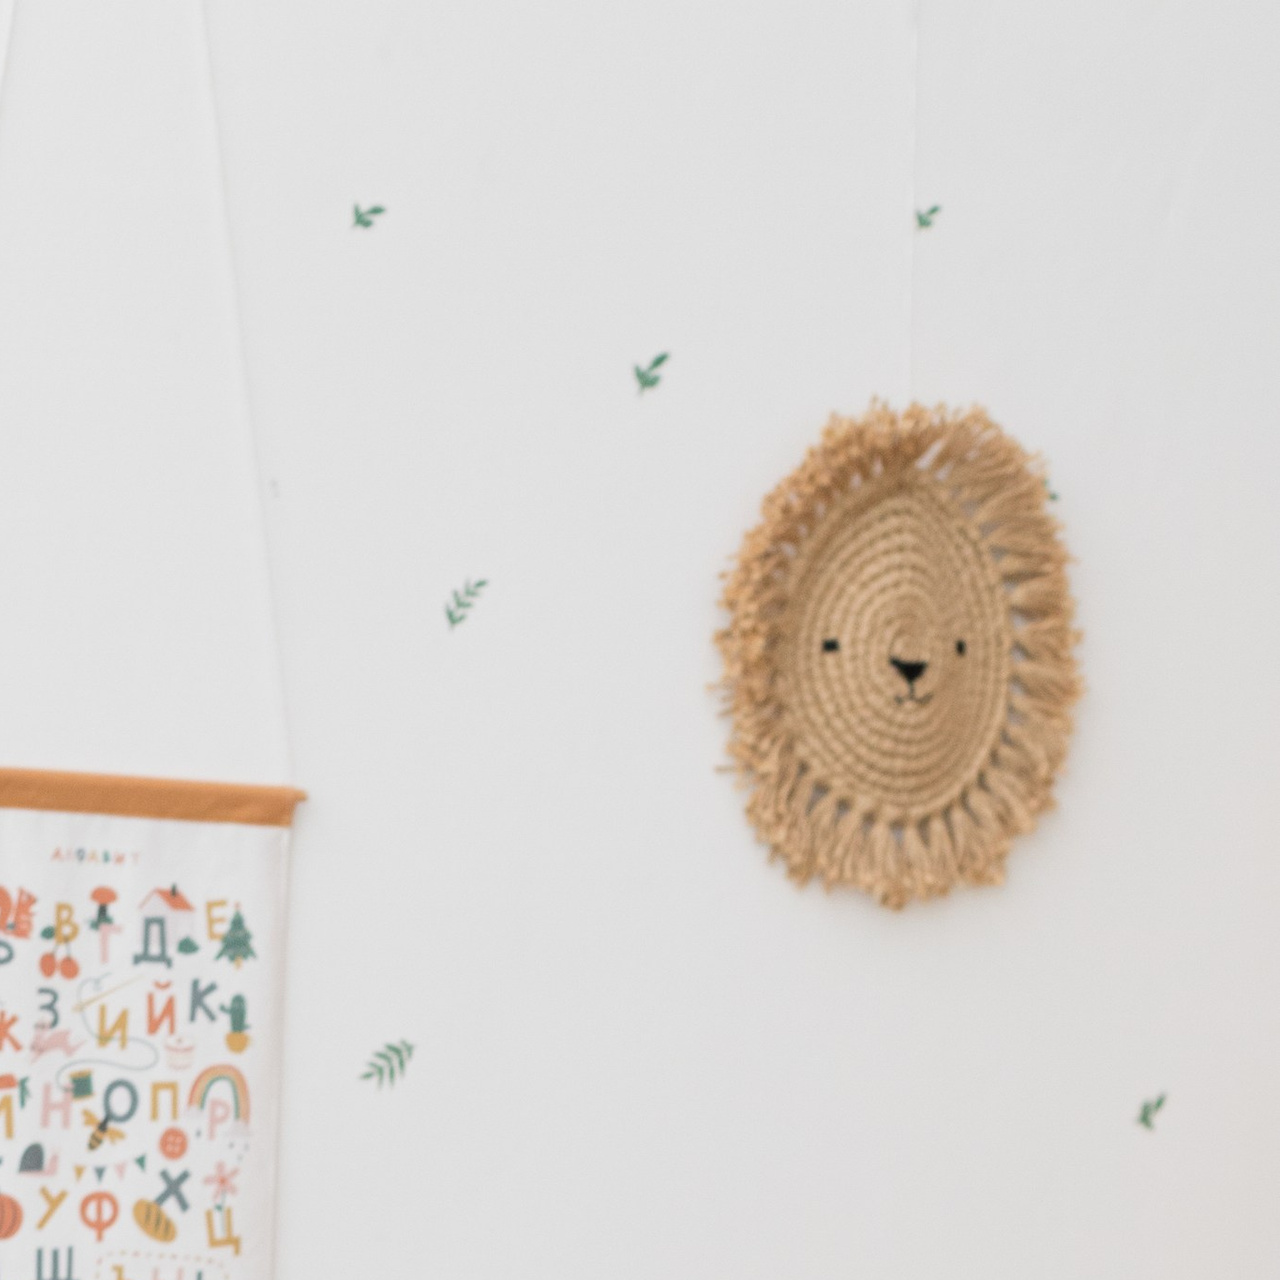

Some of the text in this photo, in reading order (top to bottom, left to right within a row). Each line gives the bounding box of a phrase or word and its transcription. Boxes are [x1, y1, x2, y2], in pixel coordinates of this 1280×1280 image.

[55, 902, 78, 944] В
[99, 922, 123, 963] Г
[133, 916, 172, 968] Д
[206, 899, 227, 941] Е
[37, 987, 58, 1028] З
[97, 1003, 128, 1050] И
[147, 980, 176, 1035] Й
[190, 978, 217, 1023] К
[40, 1082, 73, 1129] Н
[151, 1081, 178, 1121] П
[208, 1098, 230, 1140] Р
[36, 1185, 67, 1229] У
[79, 1191, 119, 1242] Ф
[155, 1168, 190, 1212] Х
[205, 1207, 241, 1256] Ц
